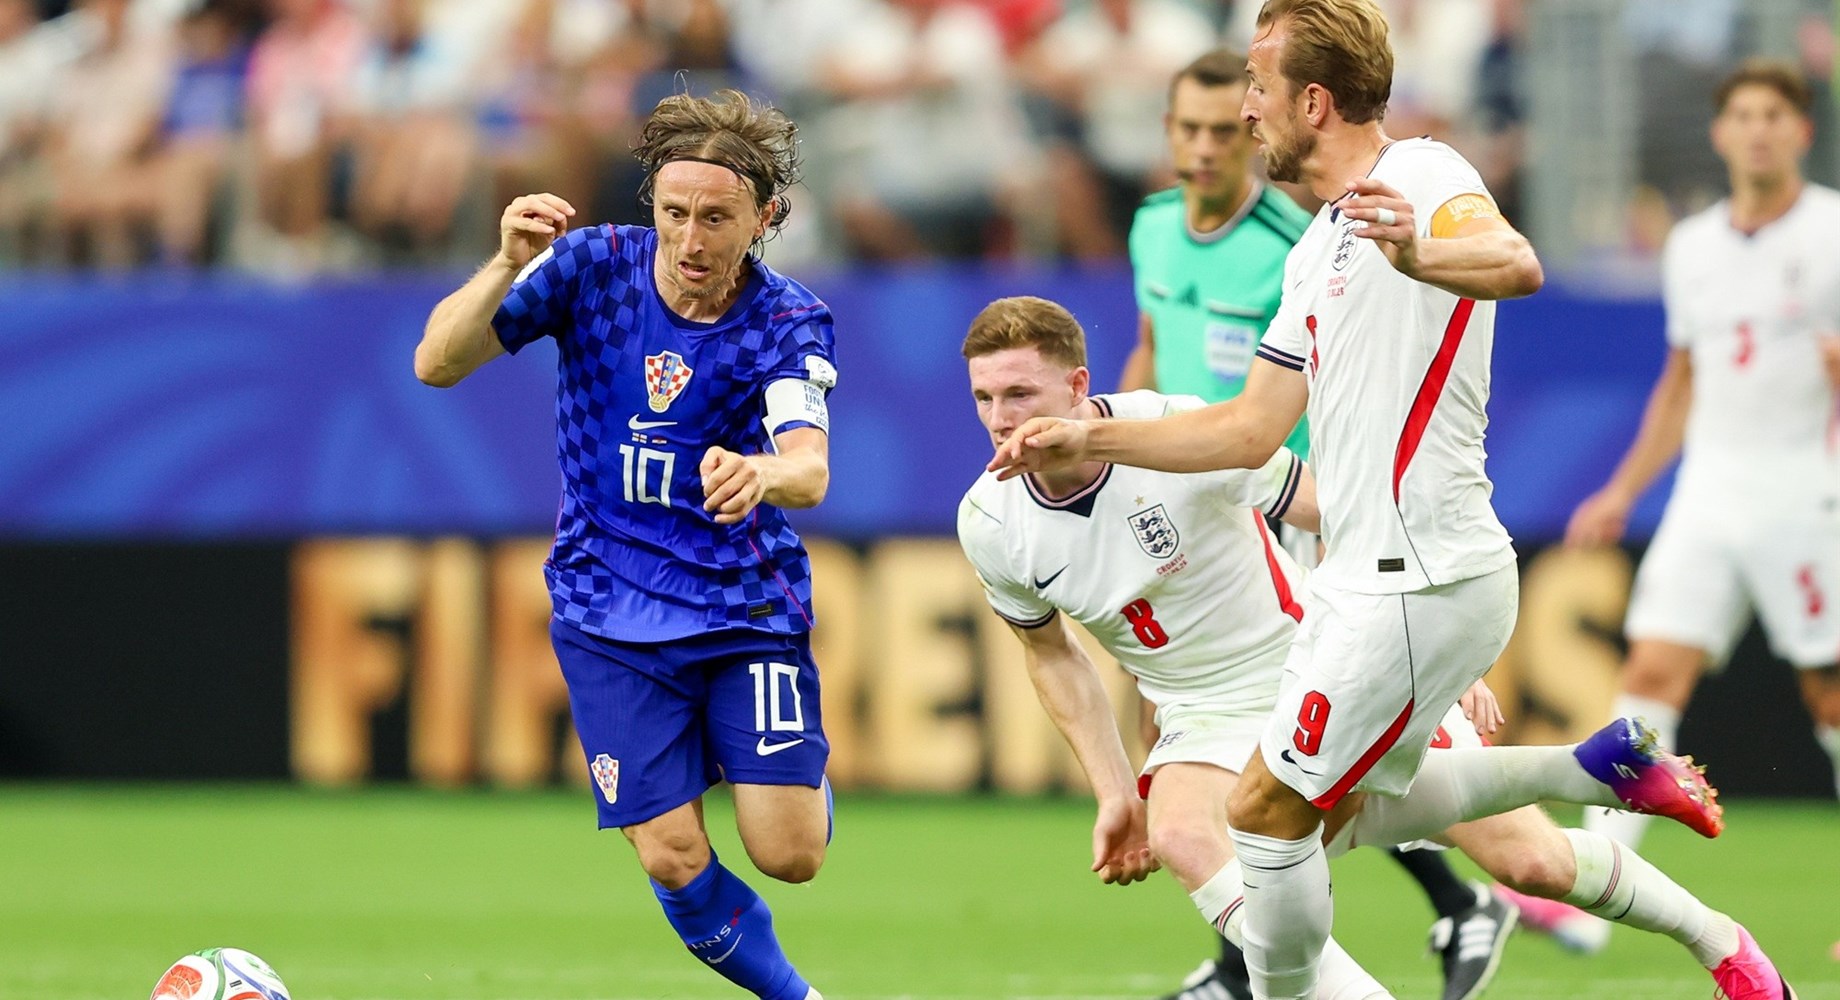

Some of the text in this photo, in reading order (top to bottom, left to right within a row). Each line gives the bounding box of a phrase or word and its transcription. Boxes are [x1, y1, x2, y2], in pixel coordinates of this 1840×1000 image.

[619, 443, 676, 509] 10
[1119, 597, 1170, 649] 8
[748, 661, 805, 732] 10
[1292, 690, 1332, 757] 9
[691, 924, 732, 950] HNS
